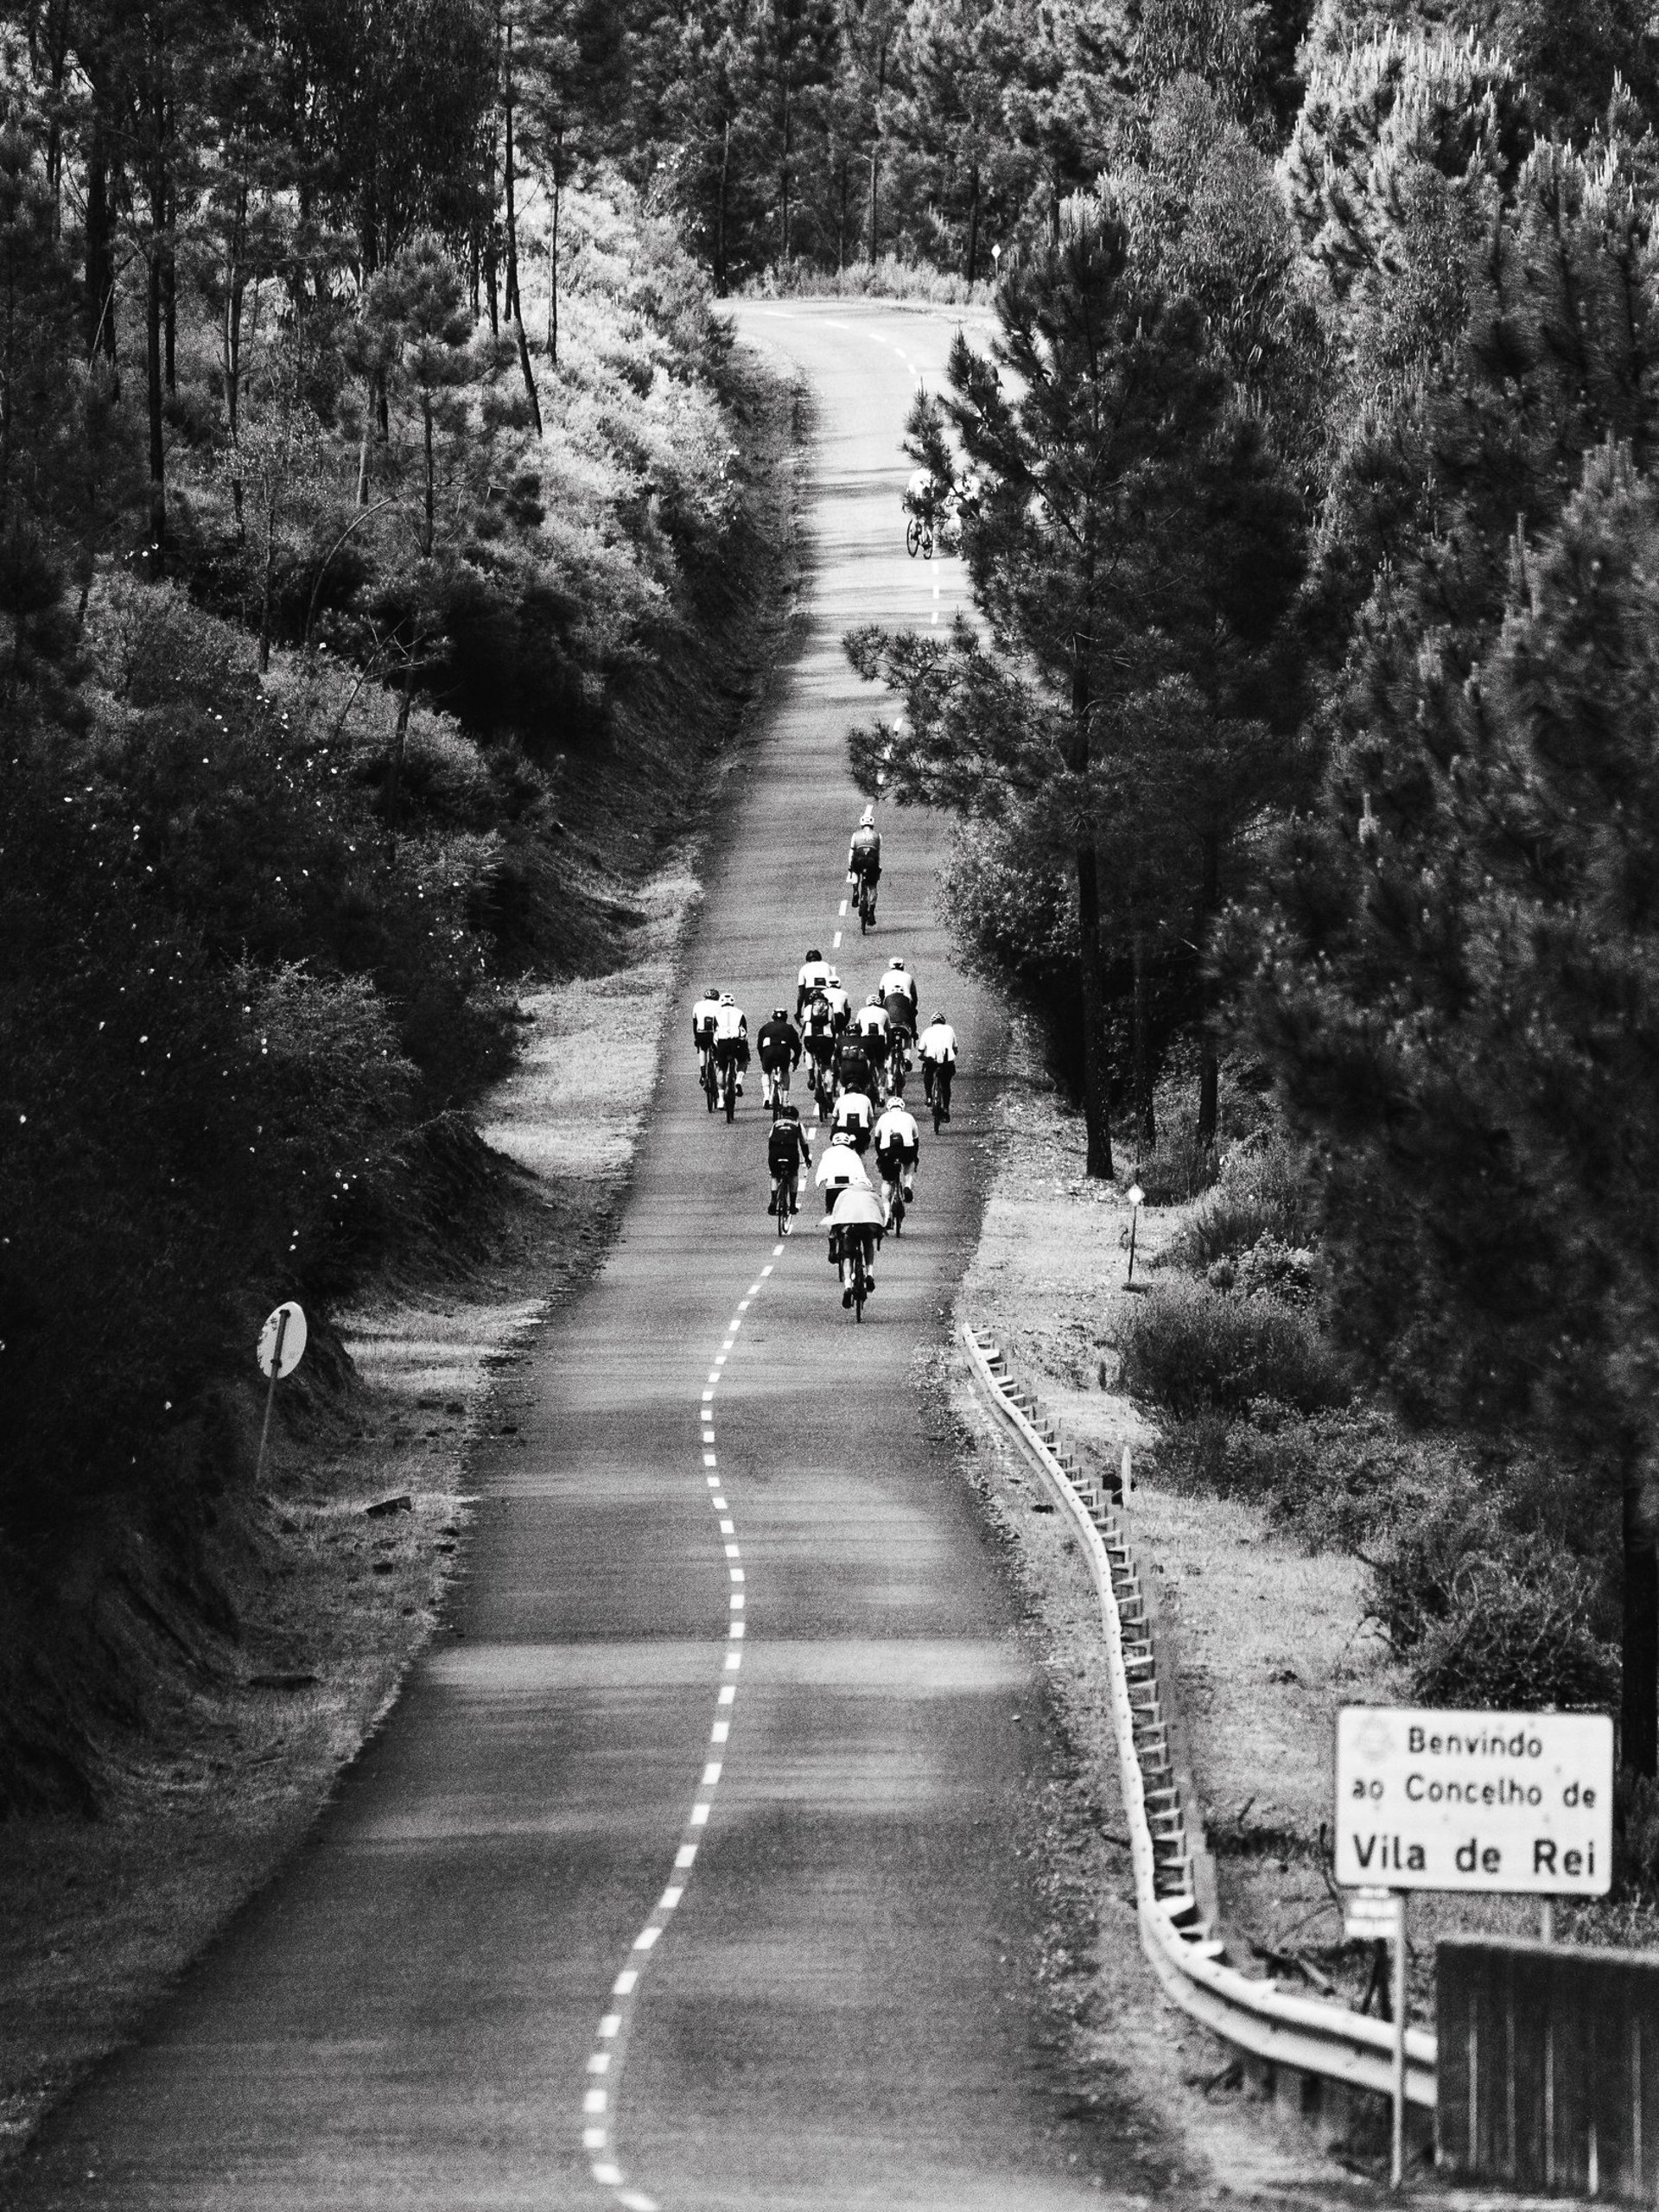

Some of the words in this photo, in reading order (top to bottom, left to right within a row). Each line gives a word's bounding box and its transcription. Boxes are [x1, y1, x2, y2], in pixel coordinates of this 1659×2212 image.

[1408, 1726, 1542, 1758] Benvindo
[1352, 1778, 1384, 1801] ao
[1405, 1772, 1543, 1807] Concelho
[1562, 1781, 1597, 1809] de
[1352, 1834, 1427, 1872] Vila
[1454, 1837, 1502, 1876] de
[1533, 1838, 1595, 1878] Rei
